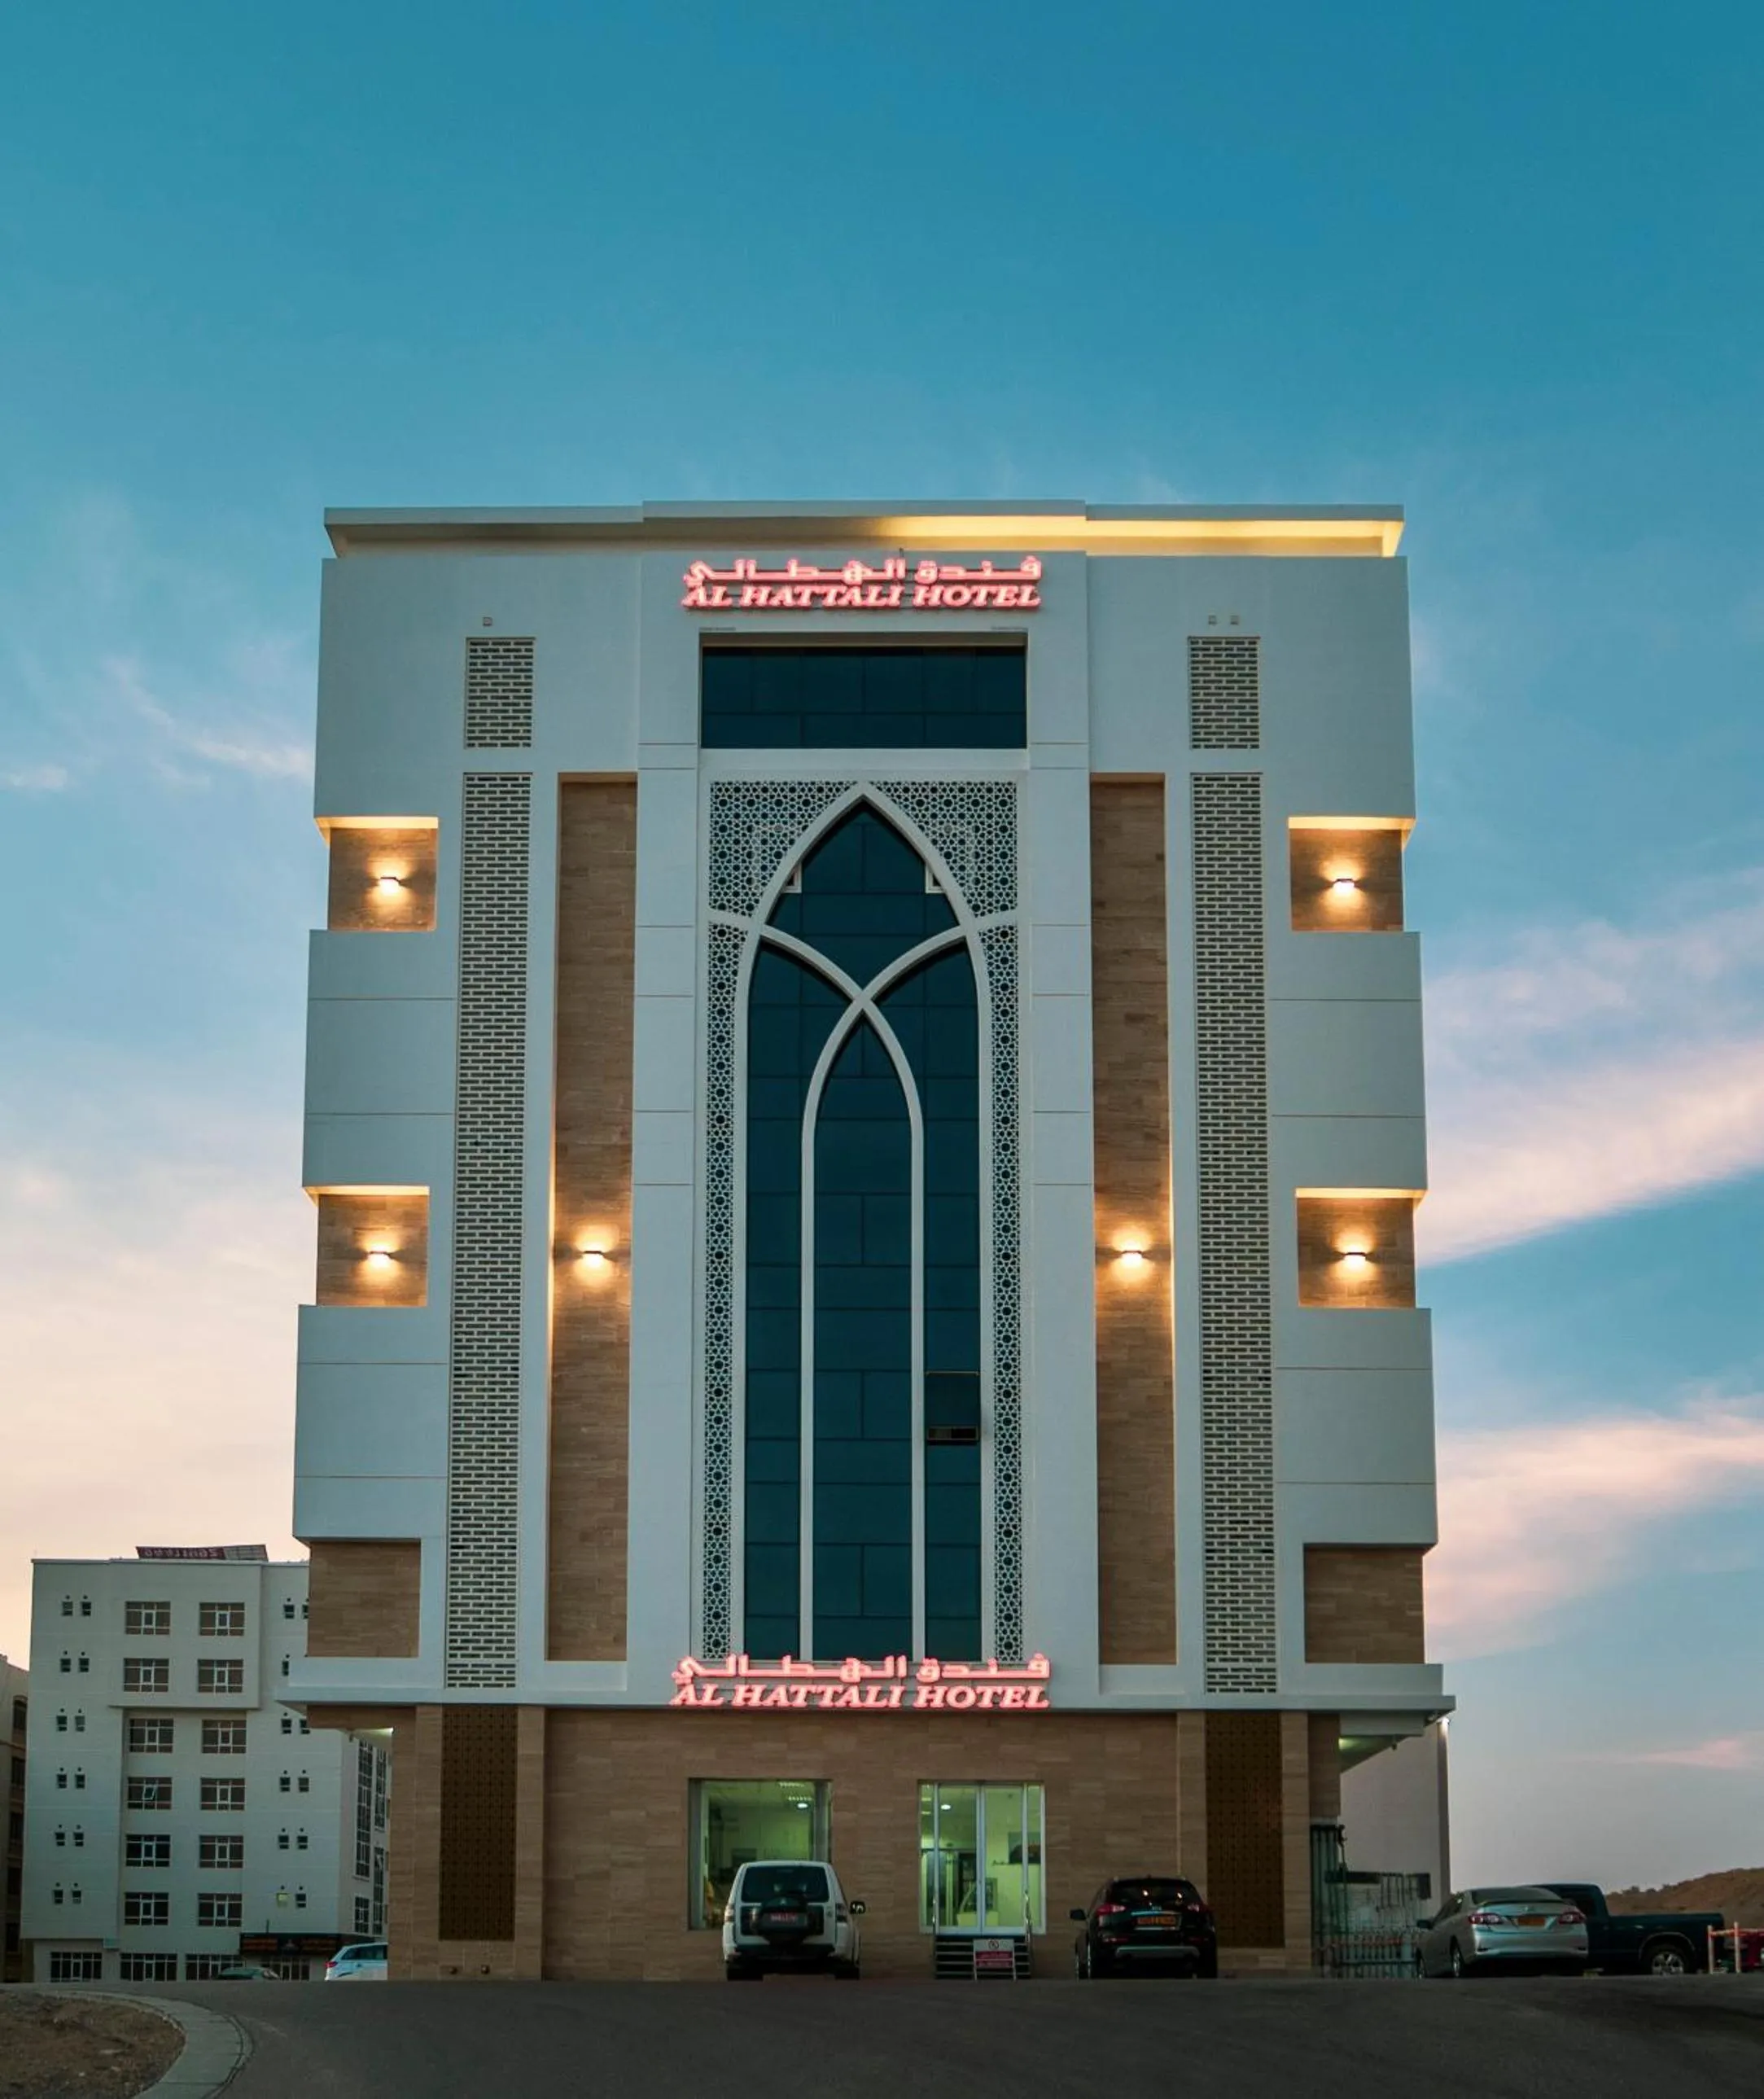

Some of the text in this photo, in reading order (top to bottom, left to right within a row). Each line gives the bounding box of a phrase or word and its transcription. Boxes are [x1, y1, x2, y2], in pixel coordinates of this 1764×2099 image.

[914, 555, 1042, 585] فندق
[680, 585, 1042, 607] AL HATTALI HOTEL
[915, 1652, 1051, 1684] فندق
[668, 1683, 1051, 1709] AL HATTALI HOTEL
